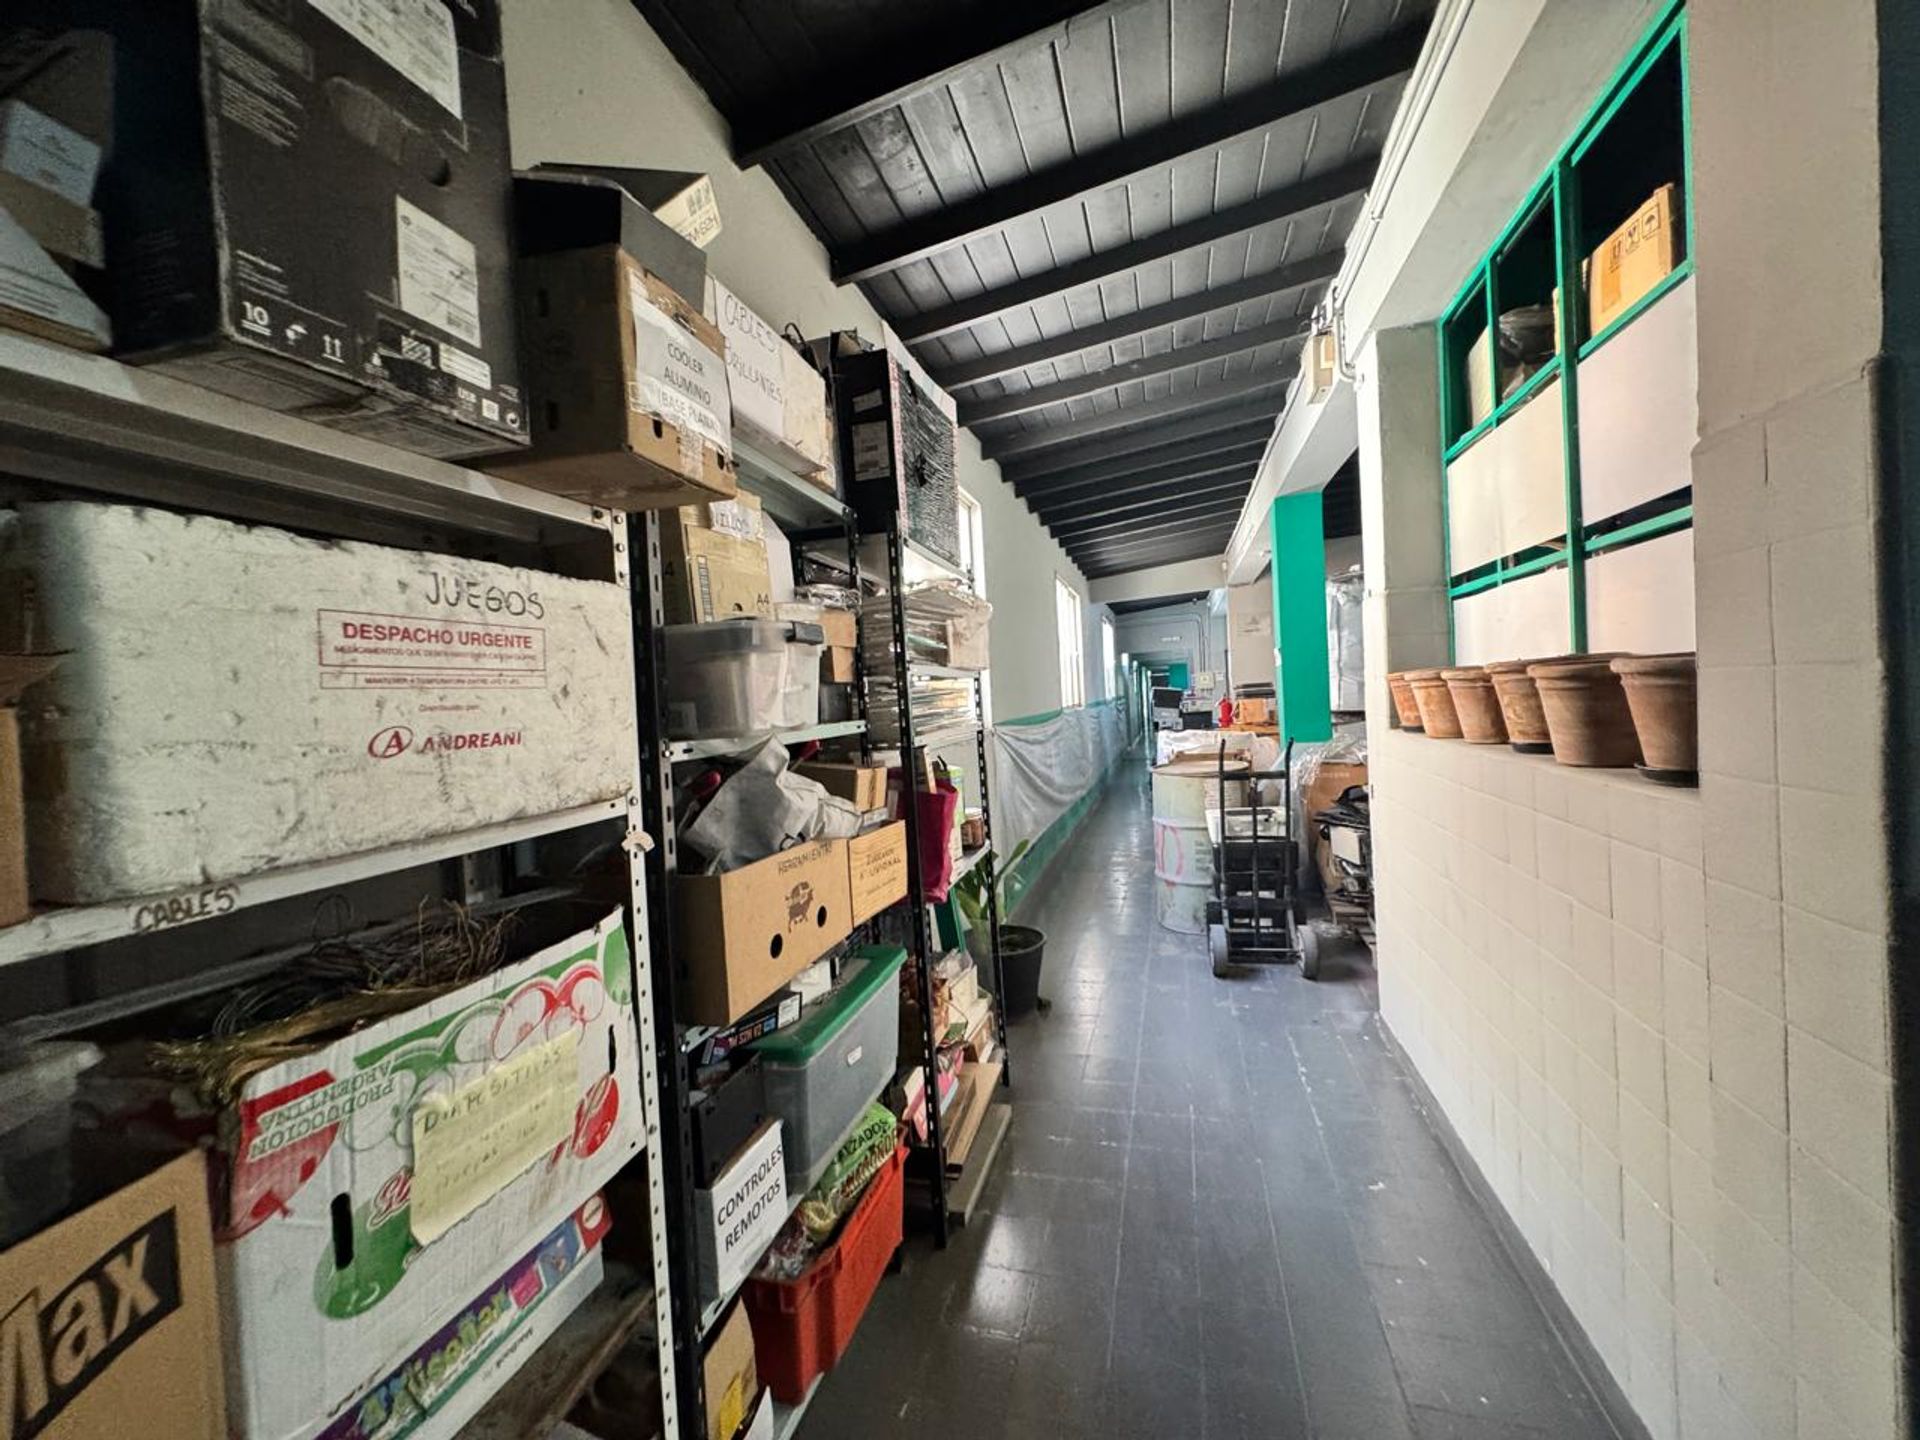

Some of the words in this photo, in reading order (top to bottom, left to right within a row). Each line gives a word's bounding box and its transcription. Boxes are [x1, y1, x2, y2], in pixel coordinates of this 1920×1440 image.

[667, 342, 703, 374] COOLER
[425, 572, 545, 620] JUEGOS
[342, 622, 454, 645] DESPACHO
[458, 631, 533, 649] URGENTE
[422, 731, 522, 752] ANDREANI
[133, 883, 238, 934] CABLES
[250, 1076, 394, 1155] PRODUCCION
[717, 1145, 782, 1226] CONTROLES
[725, 1178, 780, 1252] REMOTOS
